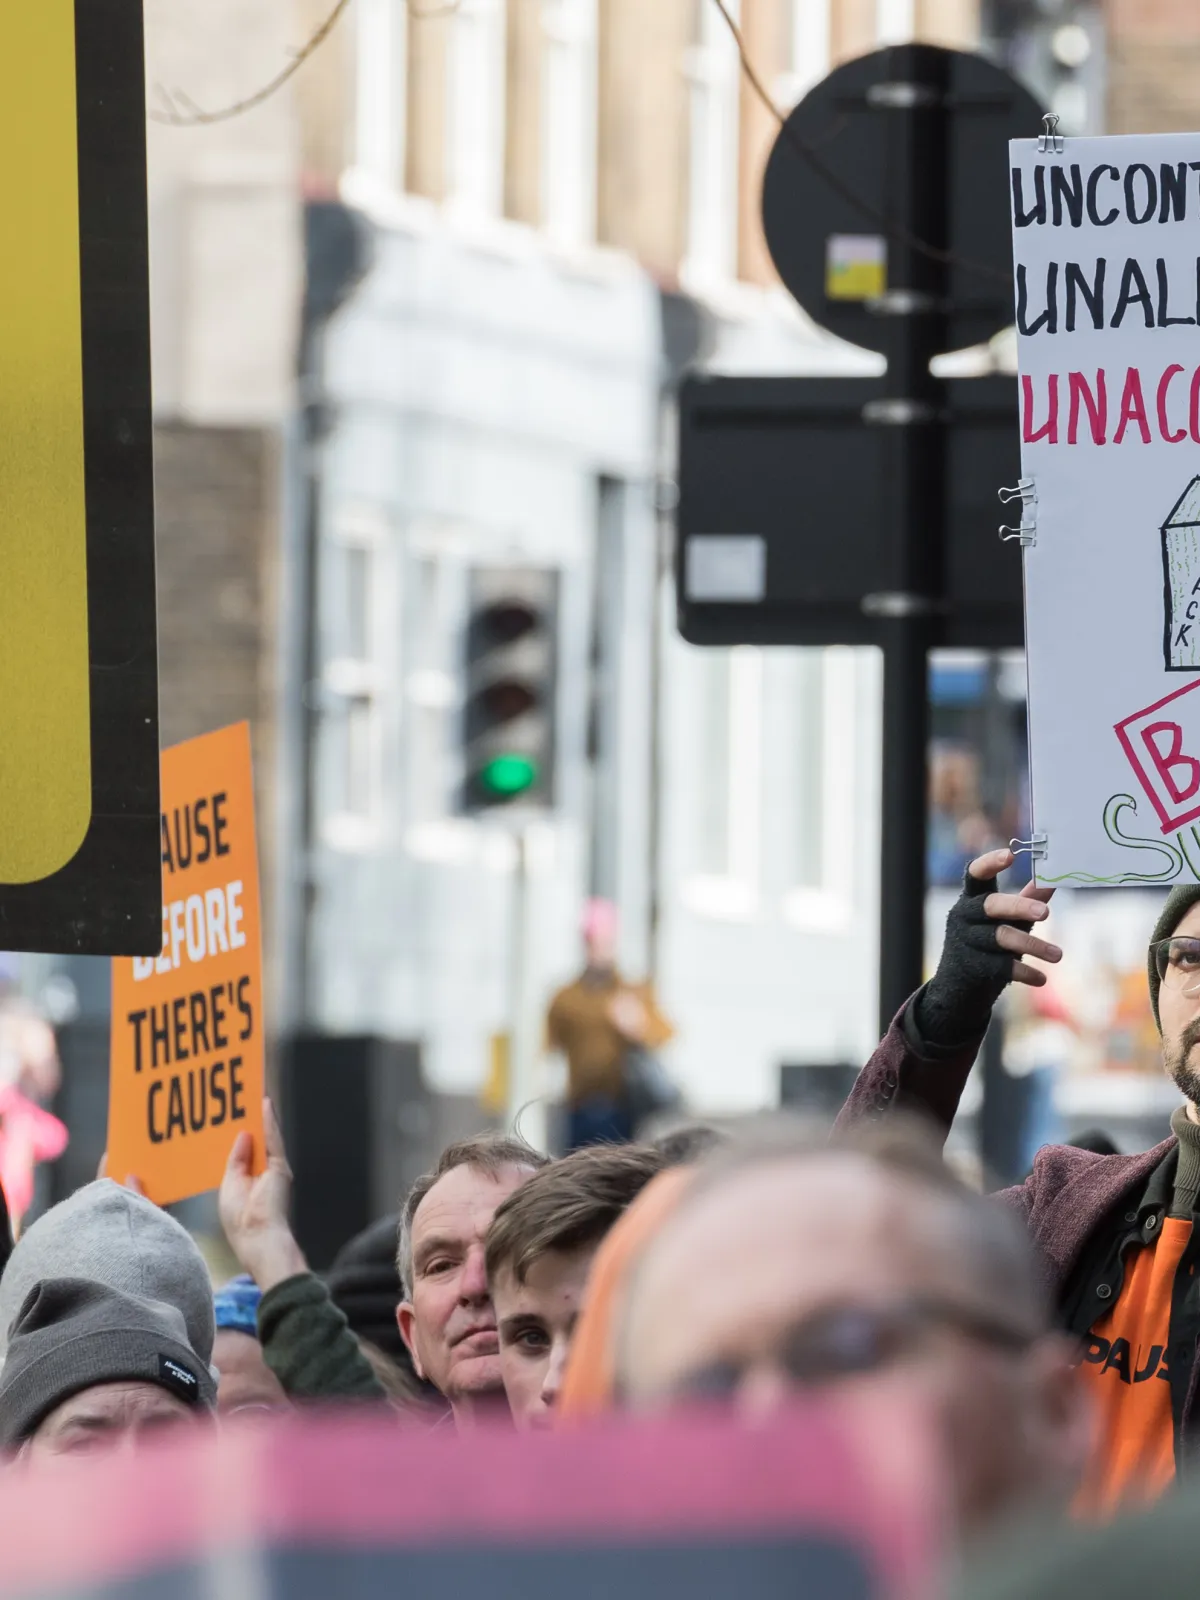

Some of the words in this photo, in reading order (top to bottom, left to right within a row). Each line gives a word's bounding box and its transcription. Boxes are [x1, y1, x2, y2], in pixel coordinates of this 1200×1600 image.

[132, 879, 246, 981] EFORE
[127, 975, 253, 1073] THERE'S
[147, 1056, 246, 1144] CAUSE
